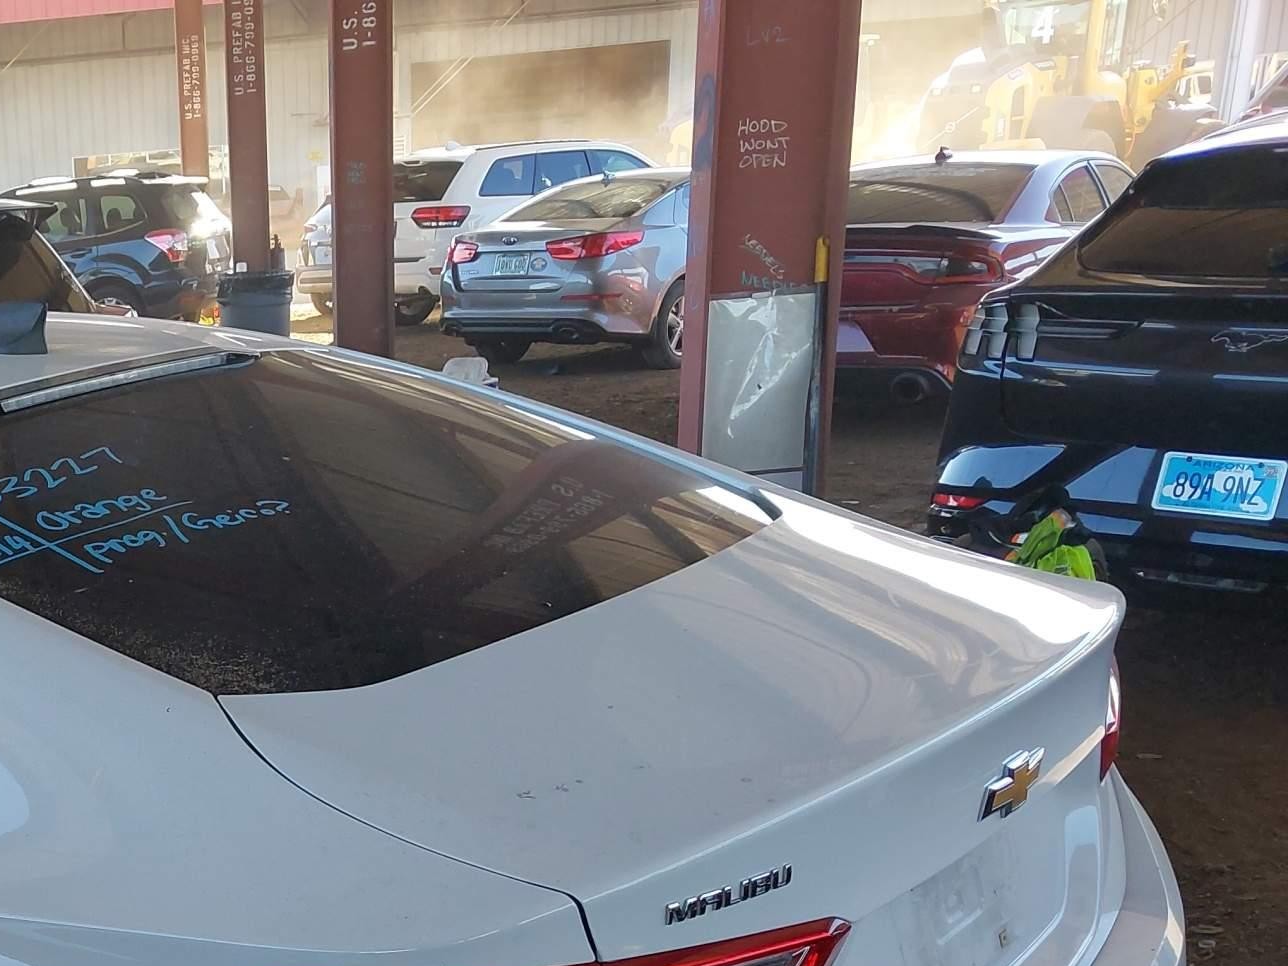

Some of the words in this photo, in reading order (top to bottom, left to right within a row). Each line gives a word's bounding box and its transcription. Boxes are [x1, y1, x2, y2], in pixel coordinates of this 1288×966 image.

[232, 11, 243, 63] PREFAB
[342, 10, 358, 51] U.S.
[183, 58, 192, 97] PREFAB
[738, 117, 788, 137] HOOD
[739, 150, 787, 169] OPEN
[740, 136, 790, 153] WONT
[1192, 460, 1255, 471] ARIZONA
[1173, 471, 1214, 502] 89A
[665, 863, 792, 926] MALIBU
